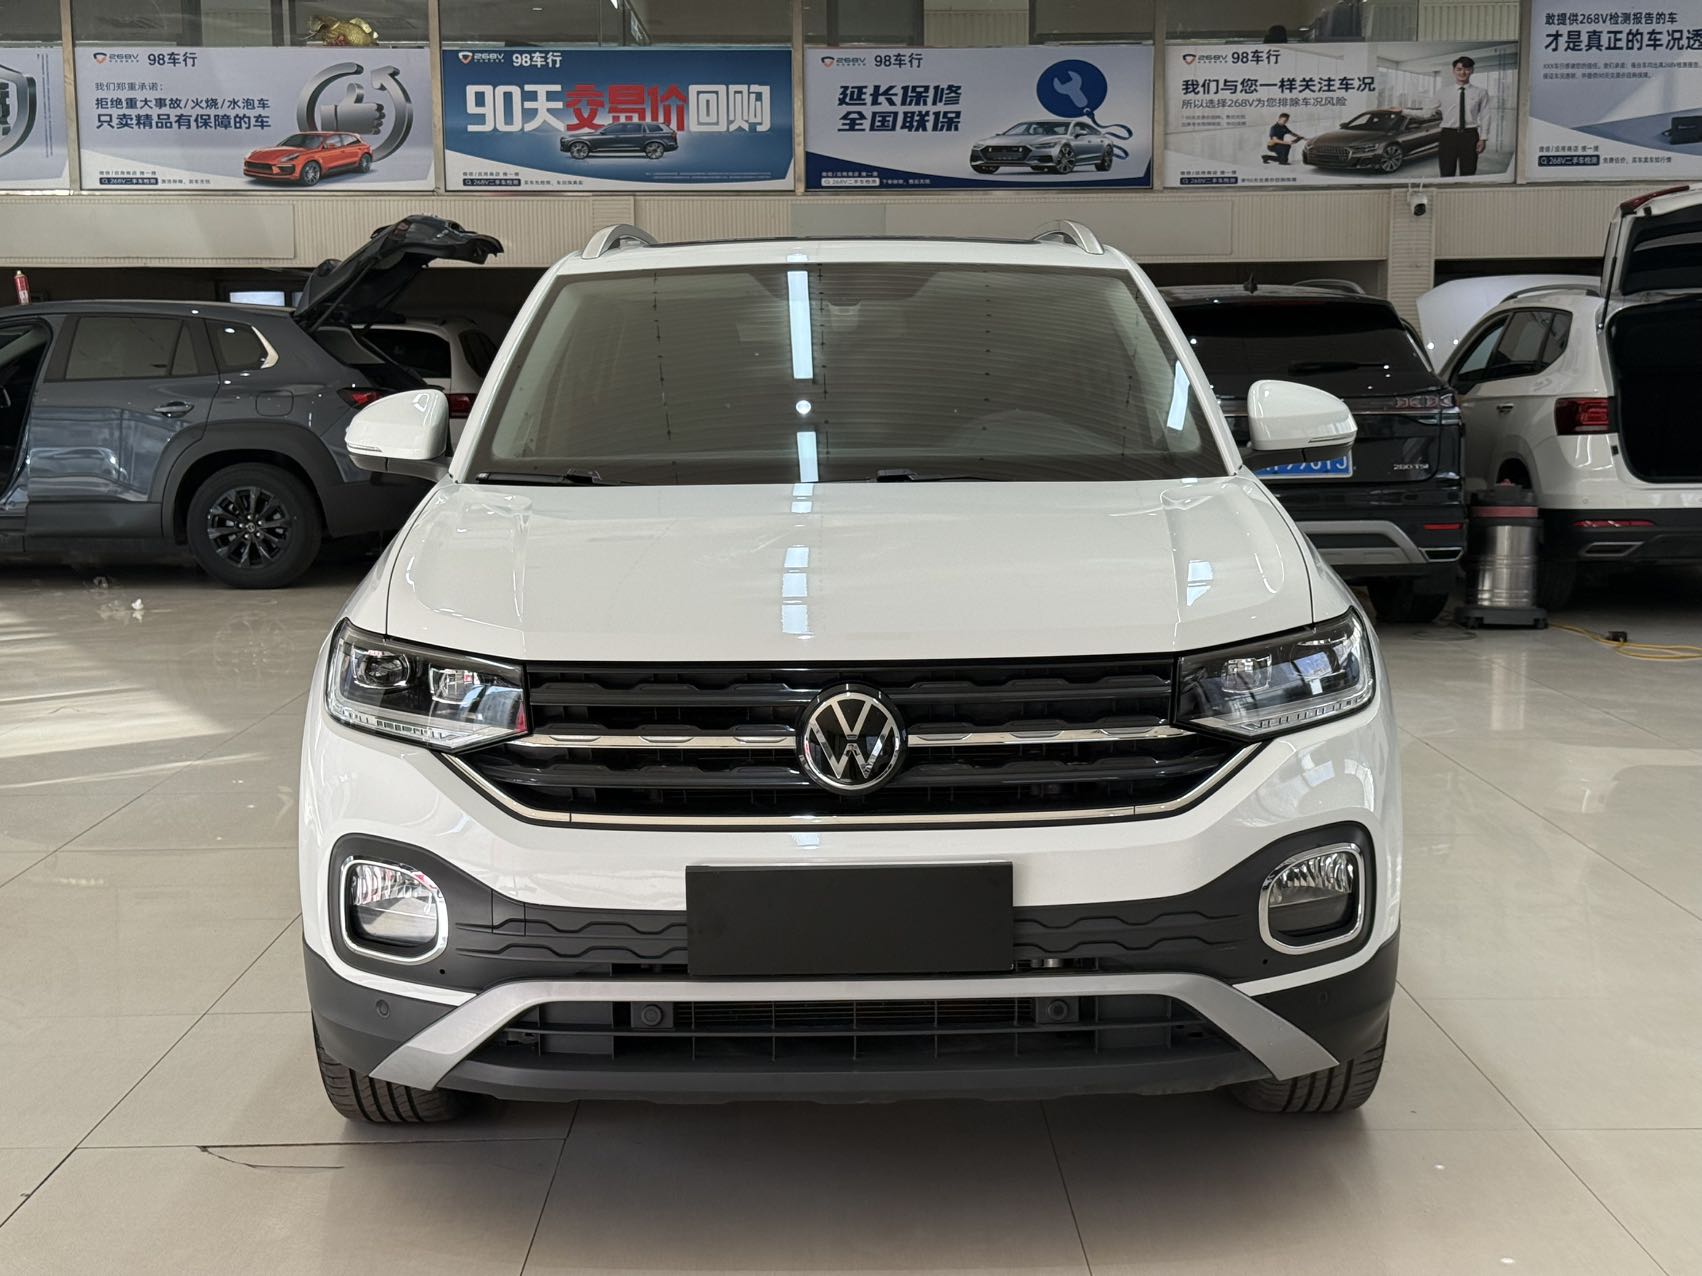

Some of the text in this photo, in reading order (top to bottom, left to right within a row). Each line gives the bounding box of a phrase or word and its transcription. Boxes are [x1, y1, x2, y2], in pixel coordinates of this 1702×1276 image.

[1545, 12, 1678, 26] 敢提供268V检测报告的车
[1544, 28, 1702, 52] 才是真正的车况透
[148, 52, 198, 67] 98车行
[512, 52, 562, 68] 98车行
[874, 53, 923, 68] 98车行
[1231, 49, 1281, 65] 98车行
[1181, 76, 1376, 96] 我们与您一样关注车况
[837, 84, 962, 107] 延长保修
[1181, 97, 1348, 110] 所以选择268V为您排除车况风险
[95, 97, 271, 111] 拒绝重大事故/火烧/水泡车
[465, 83, 771, 133] 90天交易价回购
[95, 113, 272, 131] 只卖精品有保障的车
[837, 111, 961, 132] 全国联保
